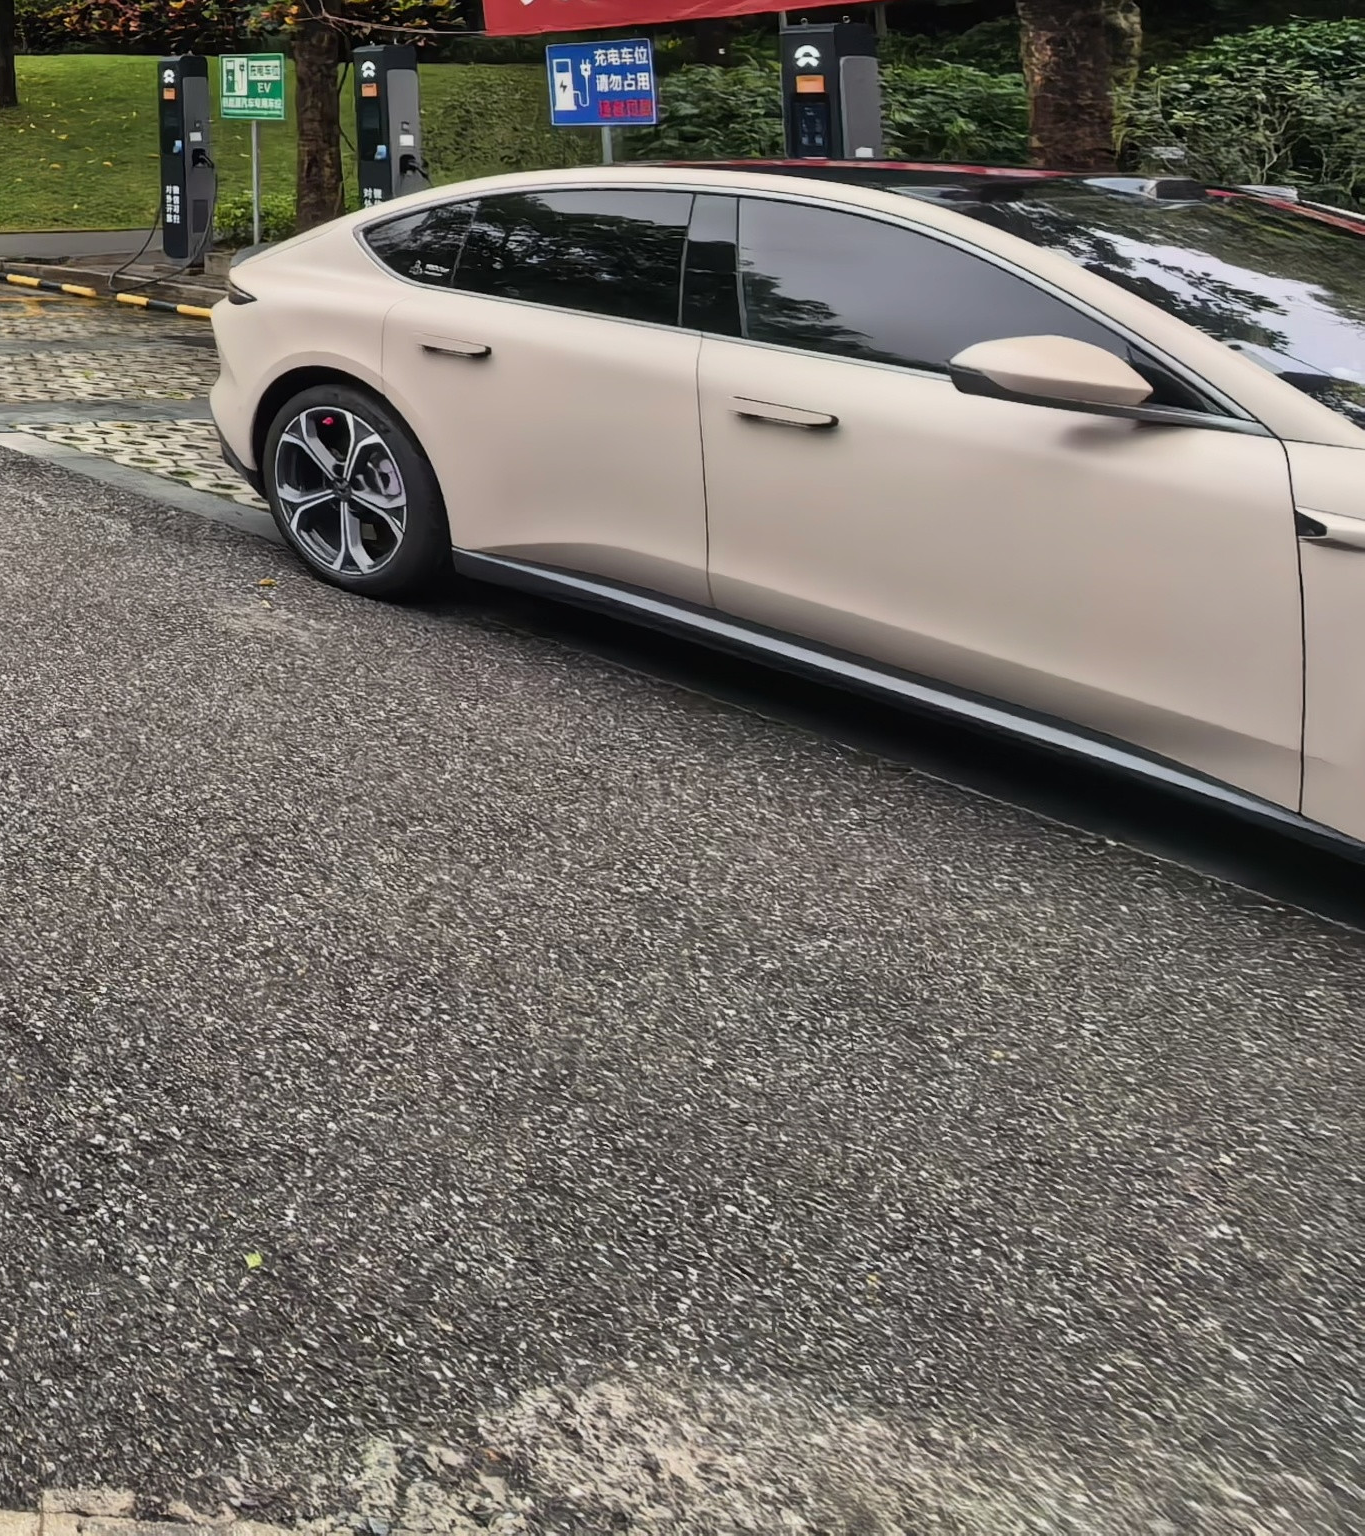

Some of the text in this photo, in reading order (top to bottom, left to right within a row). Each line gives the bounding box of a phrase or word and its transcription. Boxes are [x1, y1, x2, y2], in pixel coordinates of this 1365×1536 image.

[594, 46, 648, 66] 充电车位
[257, 82, 272, 93] EV
[596, 72, 650, 92] 请勿占用
